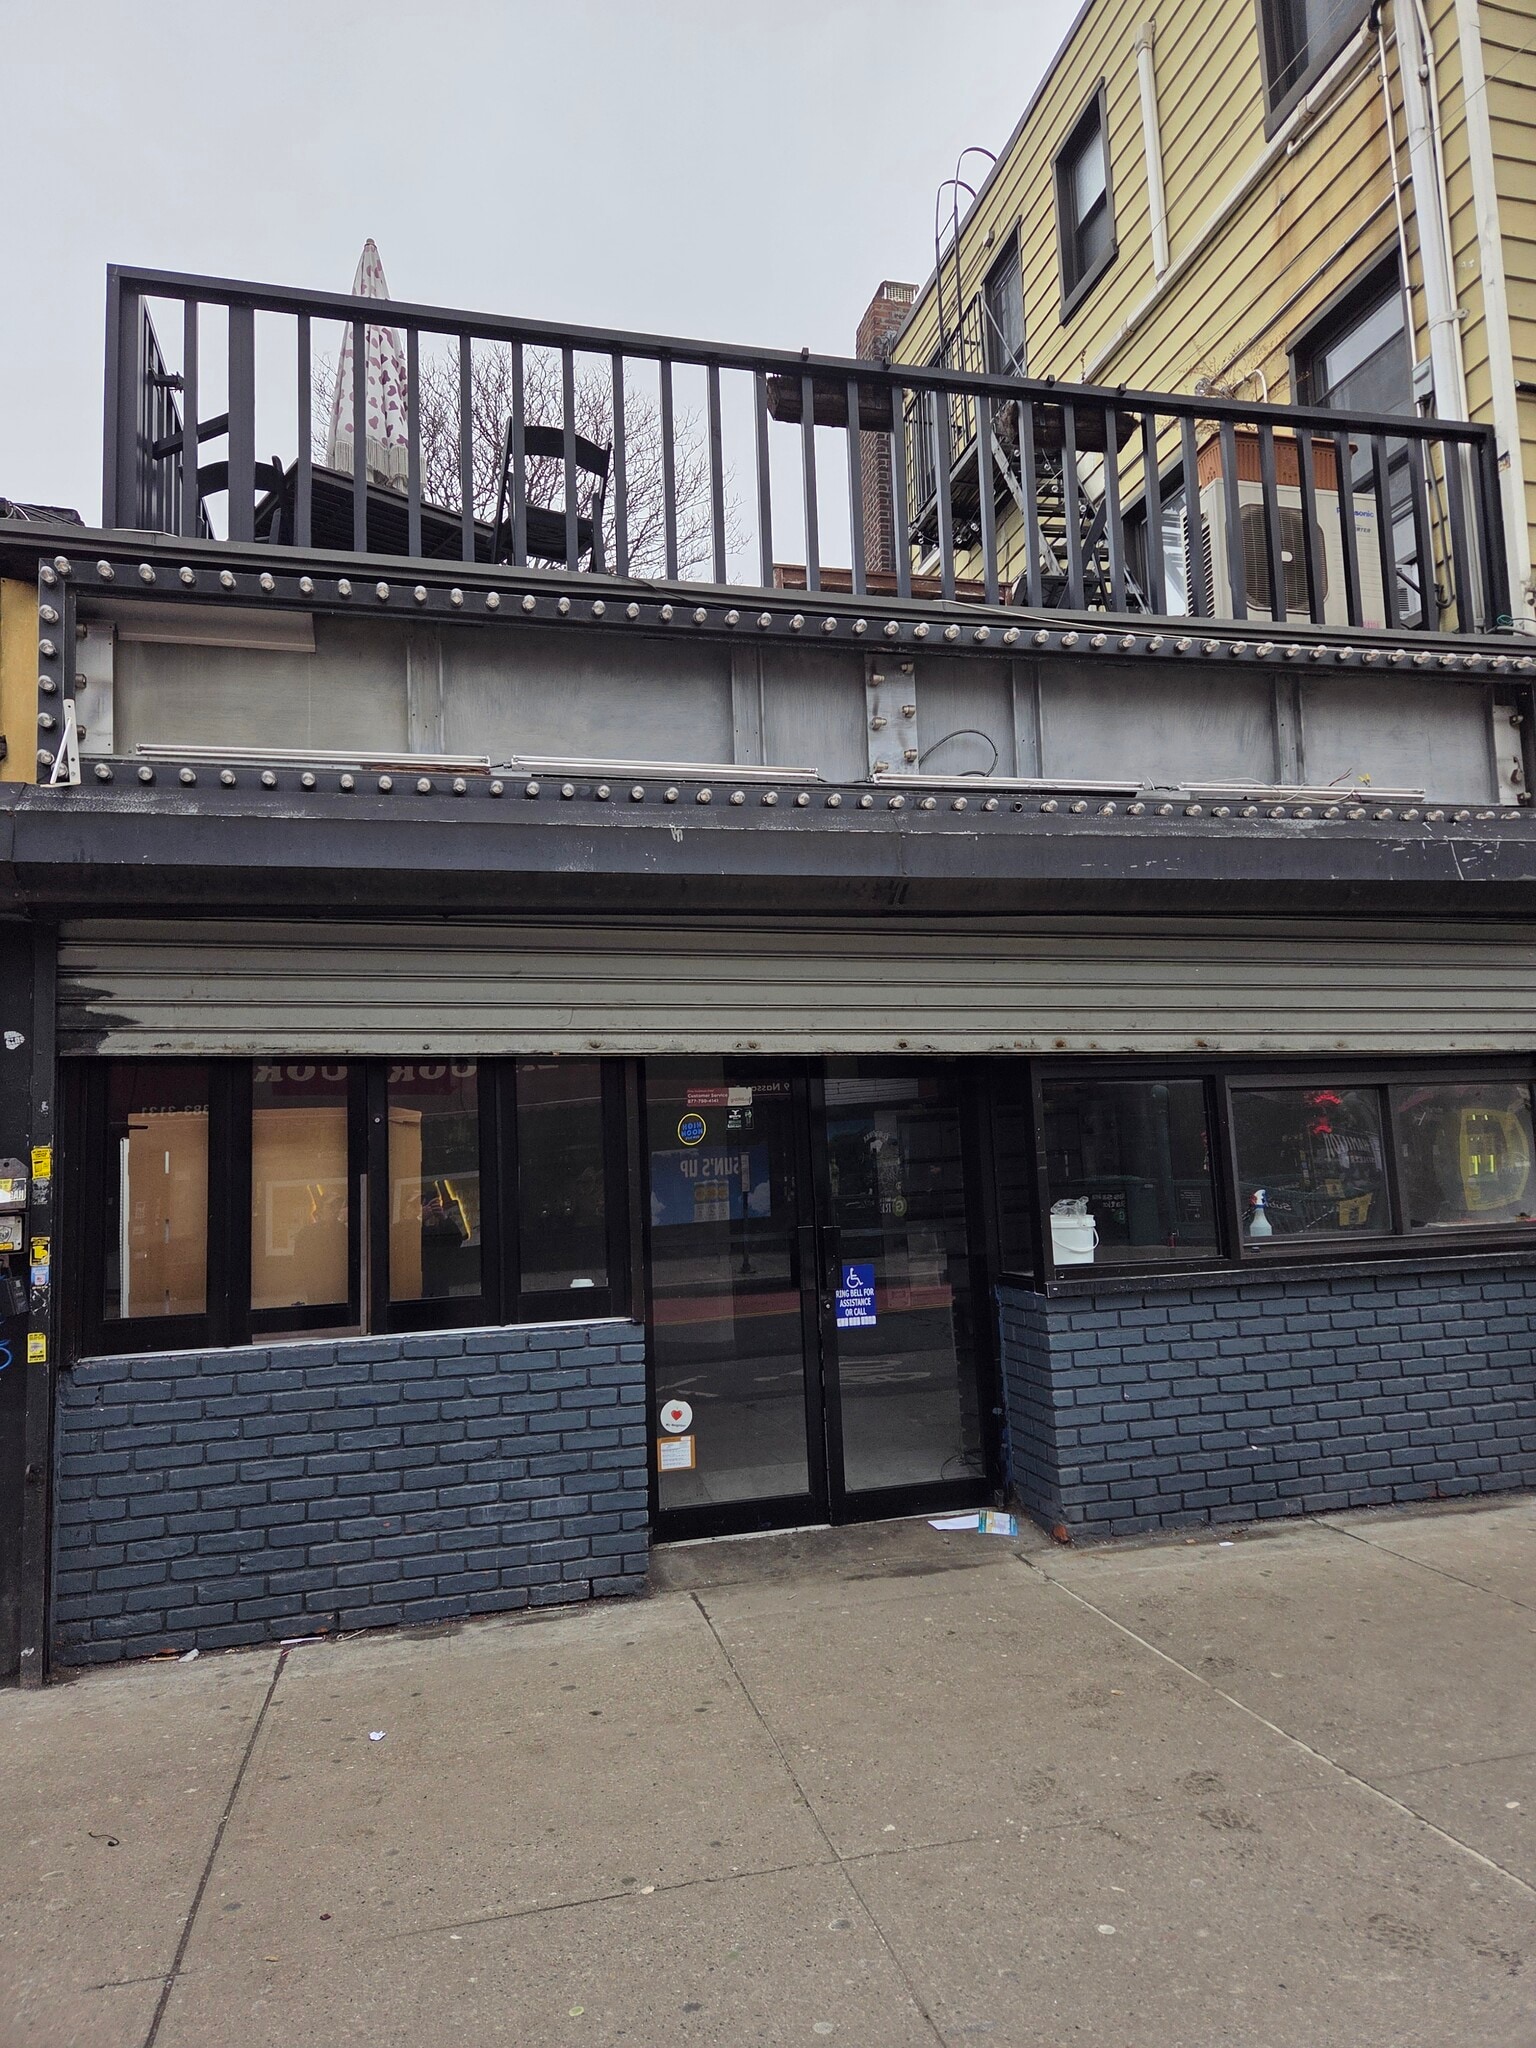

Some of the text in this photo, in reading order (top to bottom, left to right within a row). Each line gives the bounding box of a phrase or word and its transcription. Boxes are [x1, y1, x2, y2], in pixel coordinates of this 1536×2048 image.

[836, 1288, 874, 1298] RING BELL FOR
[840, 1298, 871, 1307] ASSISTANCE
[854, 1308, 867, 1316] CALL
